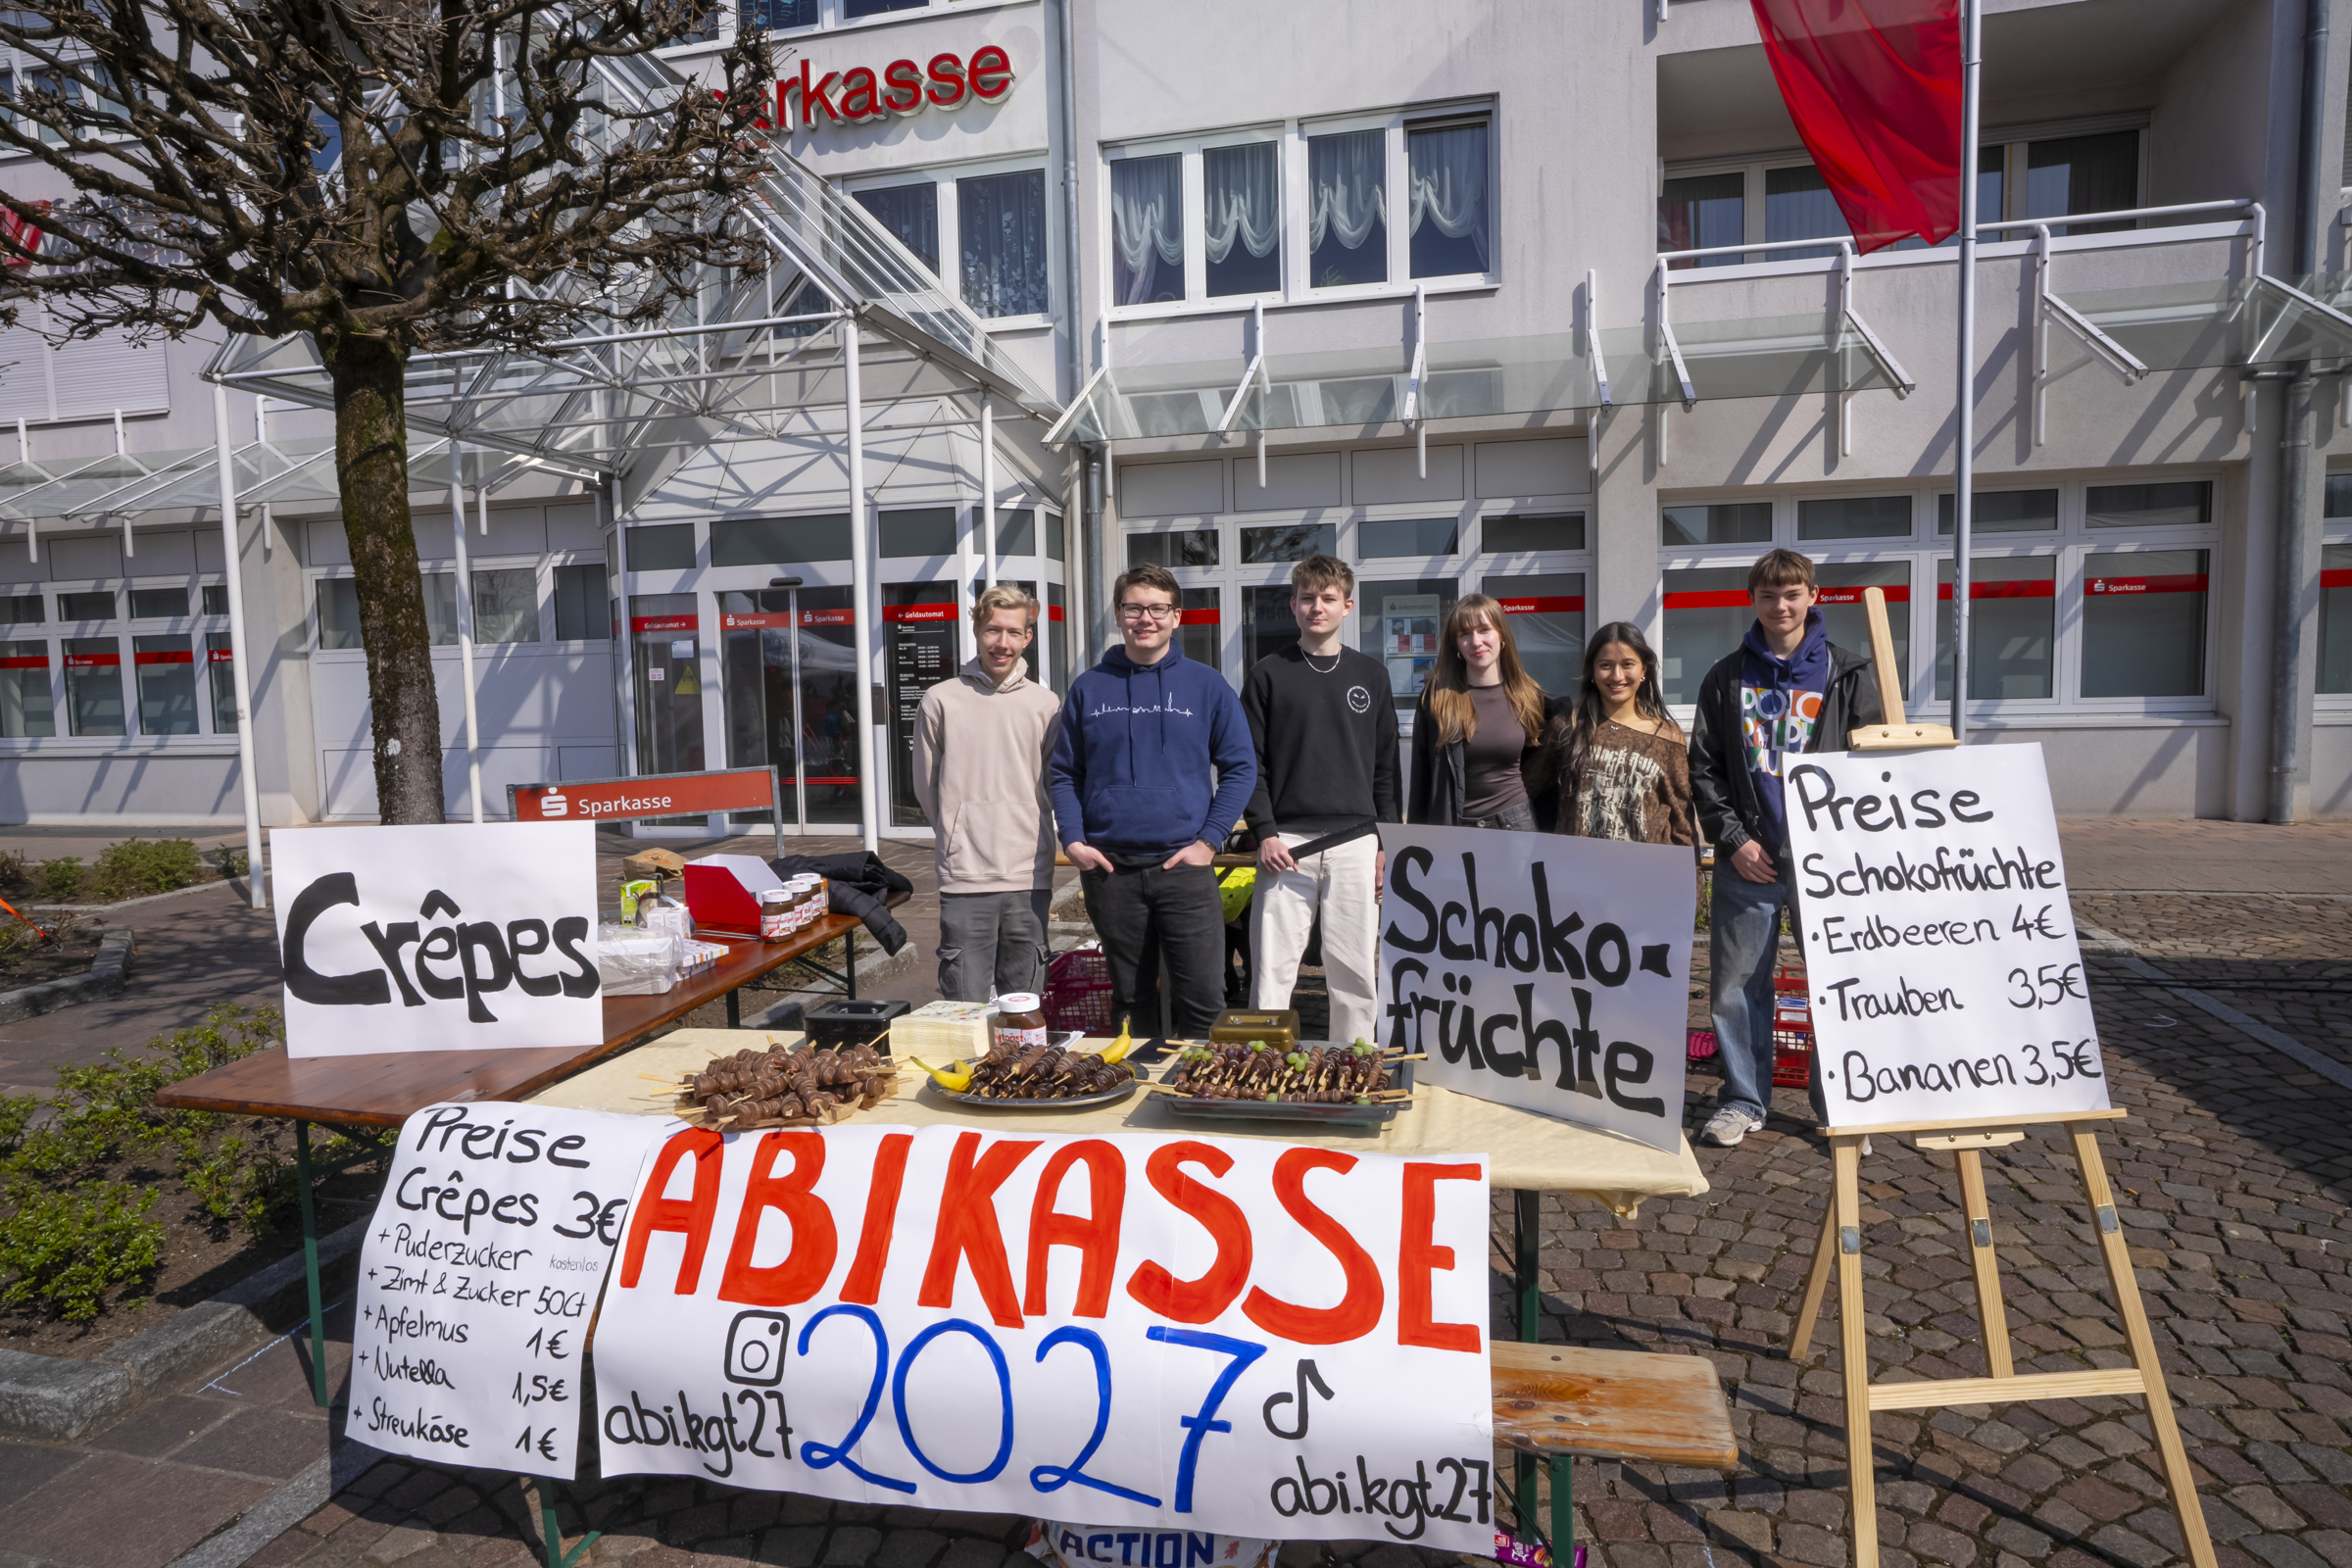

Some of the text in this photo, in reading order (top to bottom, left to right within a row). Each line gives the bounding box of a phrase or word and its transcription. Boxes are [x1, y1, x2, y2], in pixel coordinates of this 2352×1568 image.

[1503, 604, 1535, 612] Sparkasse
[1820, 594, 1854, 603] Sparkasse
[2108, 583, 2146, 593] Sparkasse
[737, 618, 765, 627] Sparkasse
[814, 614, 844, 623] Sparkasse
[578, 796, 671, 817] Sparkasse
[1788, 763, 1993, 832] Preise
[1384, 846, 1672, 987] Schoko-
[1823, 914, 2000, 954] Erdbeeren
[283, 872, 601, 1023] Crêpes
[1827, 976, 1965, 1021] Trauben
[1386, 956, 1666, 1117] früchte
[1843, 1050, 2017, 1102] Bananen
[416, 1105, 590, 1168] Preise
[396, 1166, 628, 1247] Crêpes 3€
[394, 1222, 532, 1271] Puderzucker
[619, 1127, 1482, 1353] ABIKASSE
[549, 1254, 599, 1272] kostenlos
[380, 1265, 428, 1295] Zimt
[432, 1272, 447, 1295] &
[453, 1276, 530, 1307] Zucker
[375, 1304, 468, 1344] Apfelmus
[374, 1345, 457, 1390] Nutella
[798, 1303, 1267, 1513] 2027
[604, 1390, 793, 1478] abi.kgt27
[1059, 1529, 1215, 1567] ACTION
